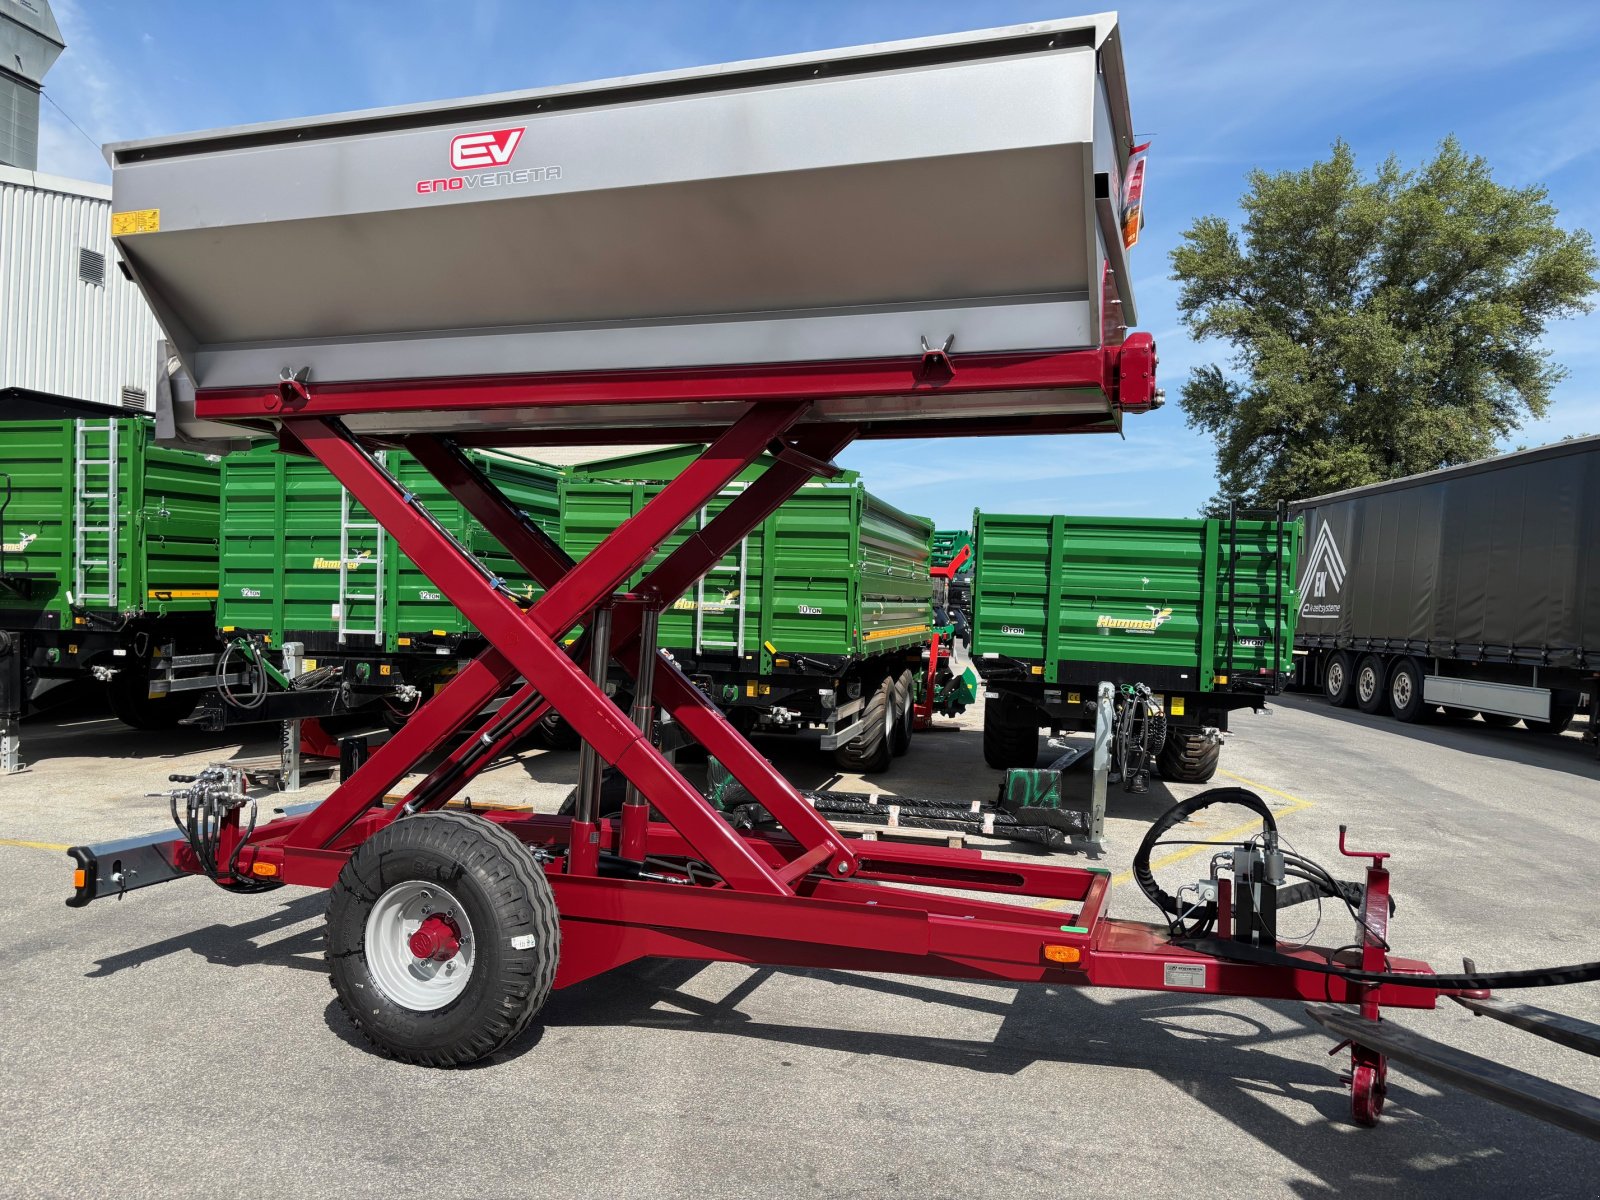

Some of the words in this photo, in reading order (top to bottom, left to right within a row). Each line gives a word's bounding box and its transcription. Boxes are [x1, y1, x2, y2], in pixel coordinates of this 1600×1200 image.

[451, 130, 523, 169] EV
[1313, 571, 1328, 597] EK
[1097, 616, 1157, 631] Hummel
